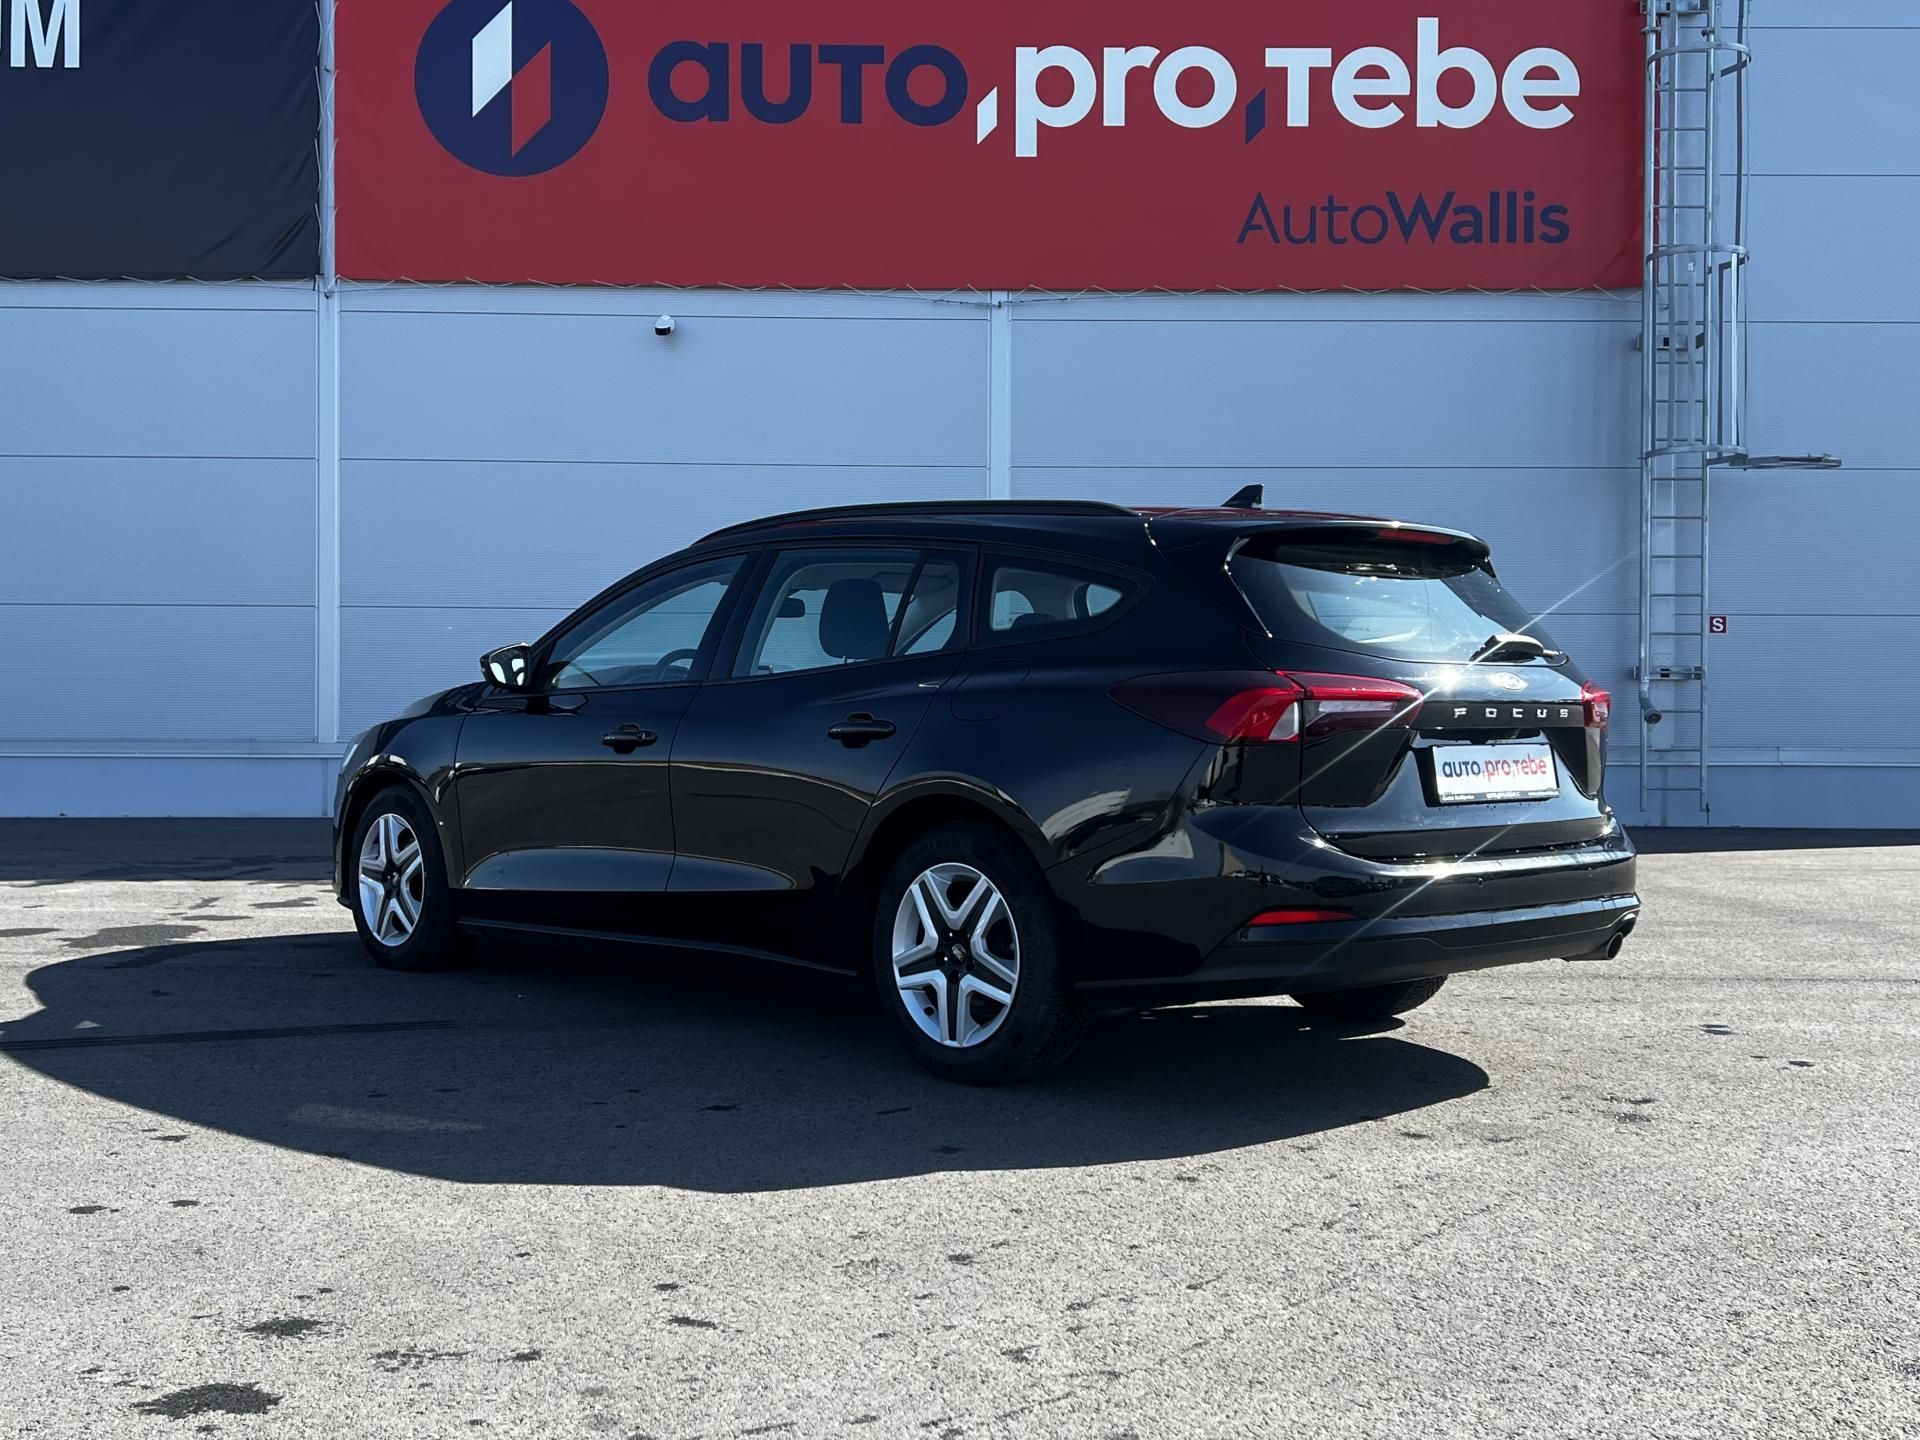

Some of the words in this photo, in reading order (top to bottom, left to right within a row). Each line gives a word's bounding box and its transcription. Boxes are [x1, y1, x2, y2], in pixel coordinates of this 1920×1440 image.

[0, 0, 80, 68] M
[1236, 191, 1570, 245] AutoWallis
[1712, 617, 1724, 632] S
[1454, 707, 1569, 718] FOCUS
